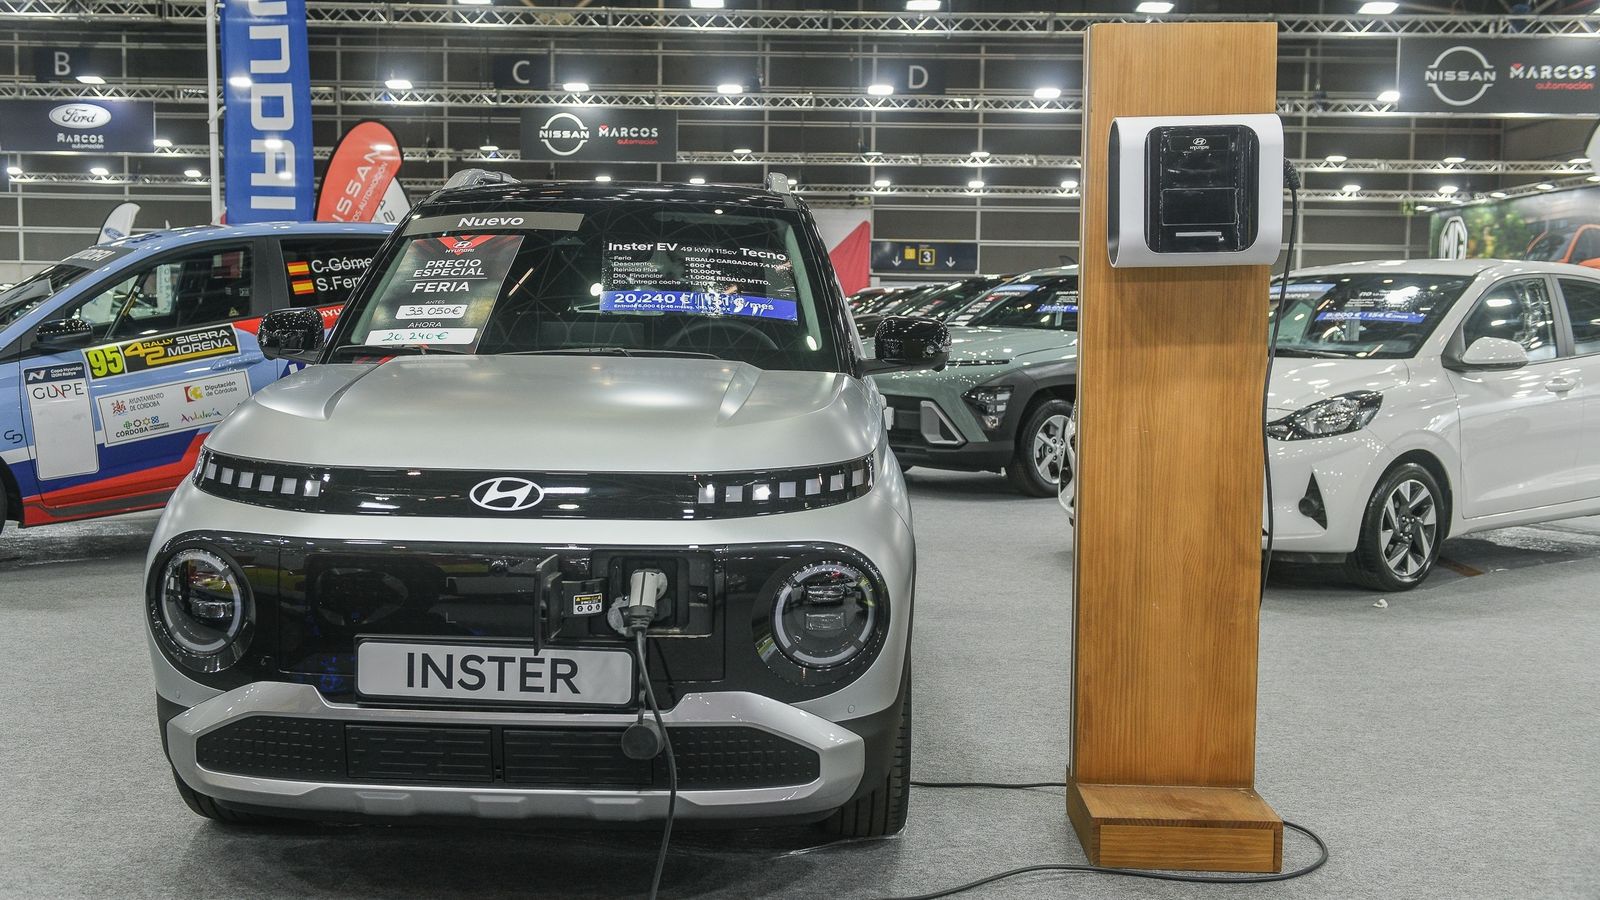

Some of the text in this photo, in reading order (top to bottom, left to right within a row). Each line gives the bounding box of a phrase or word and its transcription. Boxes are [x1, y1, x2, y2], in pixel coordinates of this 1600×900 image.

[54, 51, 71, 75] B
[512, 60, 530, 84] C
[908, 65, 929, 89] D
[1425, 71, 1496, 81] NISSAN
[1510, 64, 1597, 79] MARCOS
[61, 108, 97, 122] Ford
[539, 130, 590, 139] NISSAN
[598, 125, 659, 138] MARCOS
[57, 133, 104, 143] MARCOS
[457, 216, 525, 228] Nuevo
[608, 242, 654, 251] Inster
[656, 242, 678, 251] EV
[739, 247, 787, 261] Tecno
[923, 251, 931, 263] 3
[311, 257, 375, 273] C.Góme
[425, 259, 482, 268] PRECIO
[716, 258, 759, 267] CARGADOR
[413, 268, 485, 277] ESPECIAL
[316, 276, 361, 291] S.Fer
[716, 275, 747, 283] REGALO
[411, 281, 470, 293] FERIA
[614, 293, 676, 303] 20.240
[175, 329, 229, 343] SIERRA
[142, 338, 173, 348] RALLY
[167, 338, 233, 357] MORENA
[87, 346, 124, 377] 95
[204, 381, 236, 391] Diputación
[406, 652, 581, 695] INSTER
